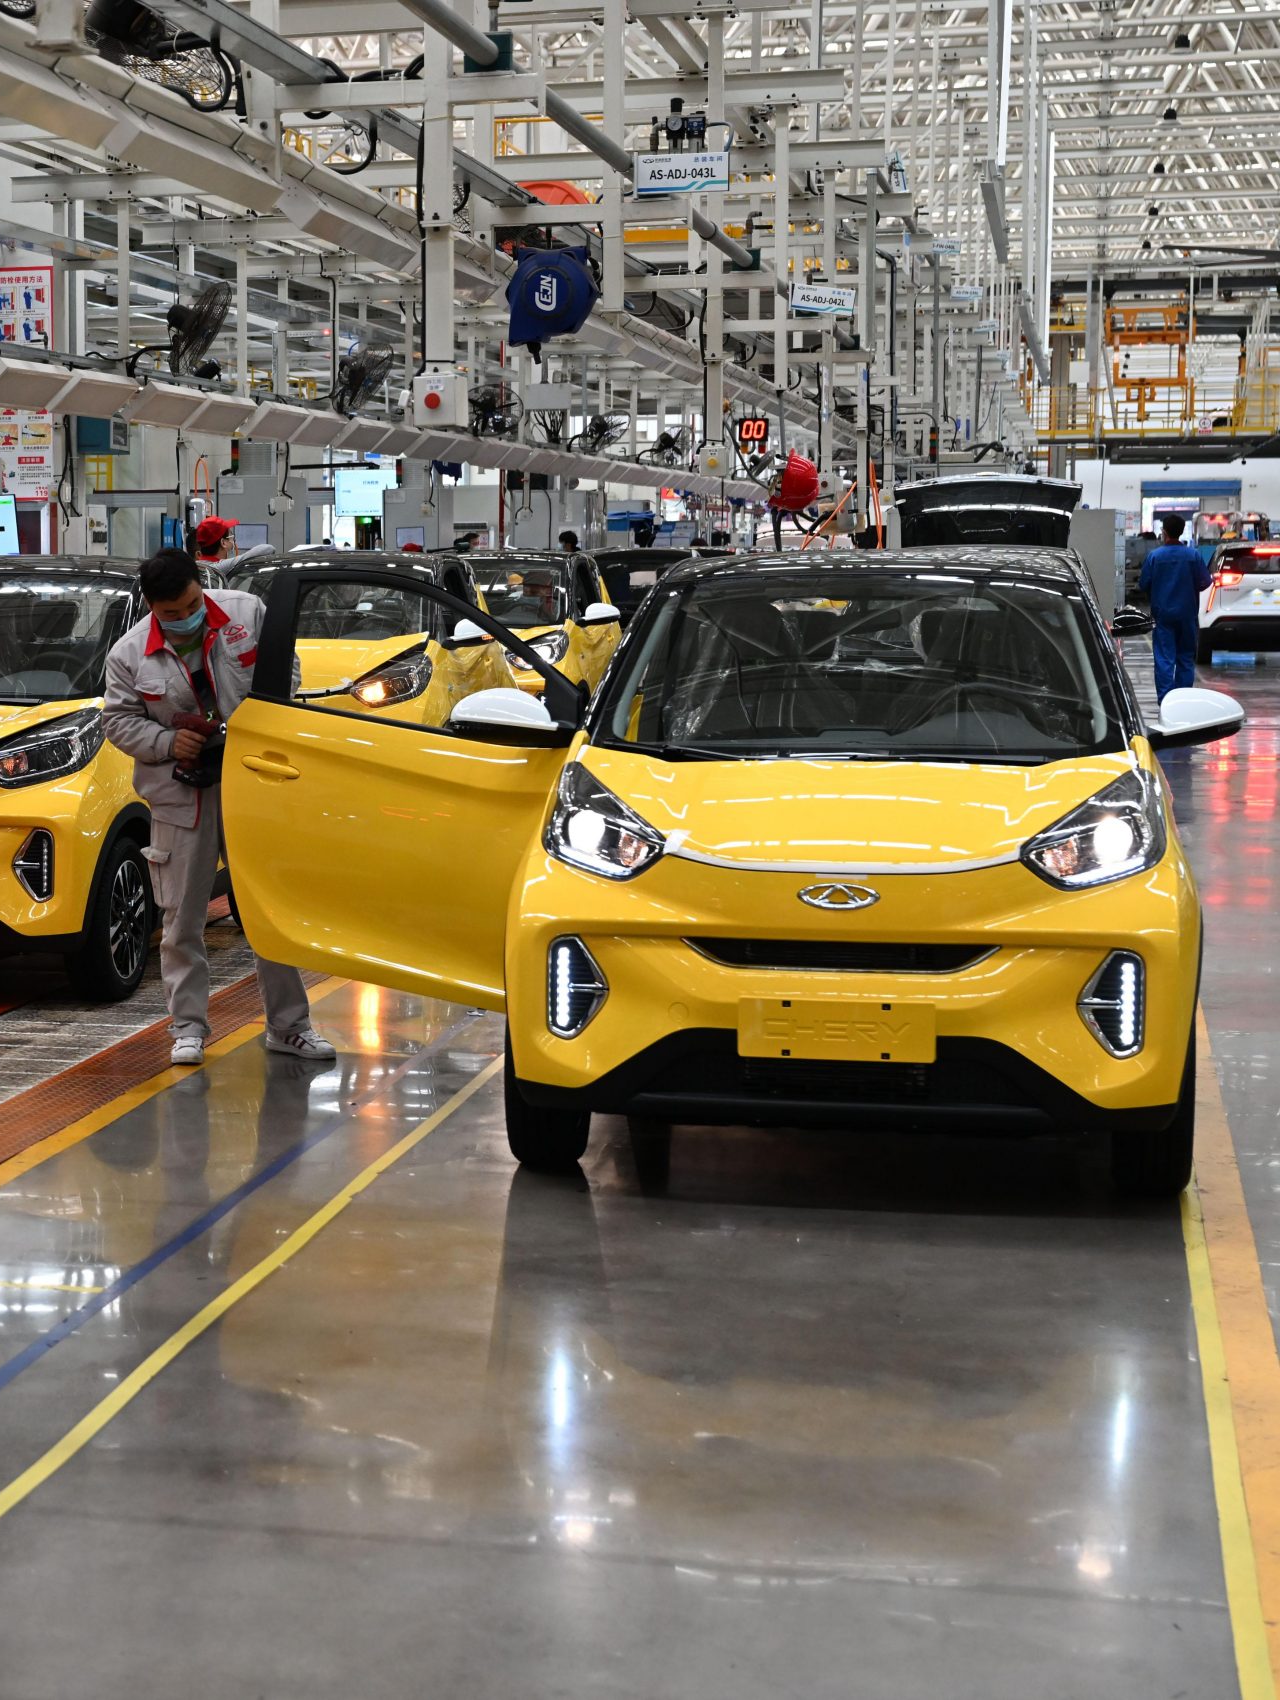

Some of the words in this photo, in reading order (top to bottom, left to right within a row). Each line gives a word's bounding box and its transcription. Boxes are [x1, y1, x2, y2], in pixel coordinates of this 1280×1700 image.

[649, 167, 716, 181] AS-ADJ-043L
[534, 274, 557, 312] CEJN
[800, 293, 846, 307] AS-ADJ-042L
[741, 420, 766, 439] 00
[762, 1018, 911, 1044] CHERY
